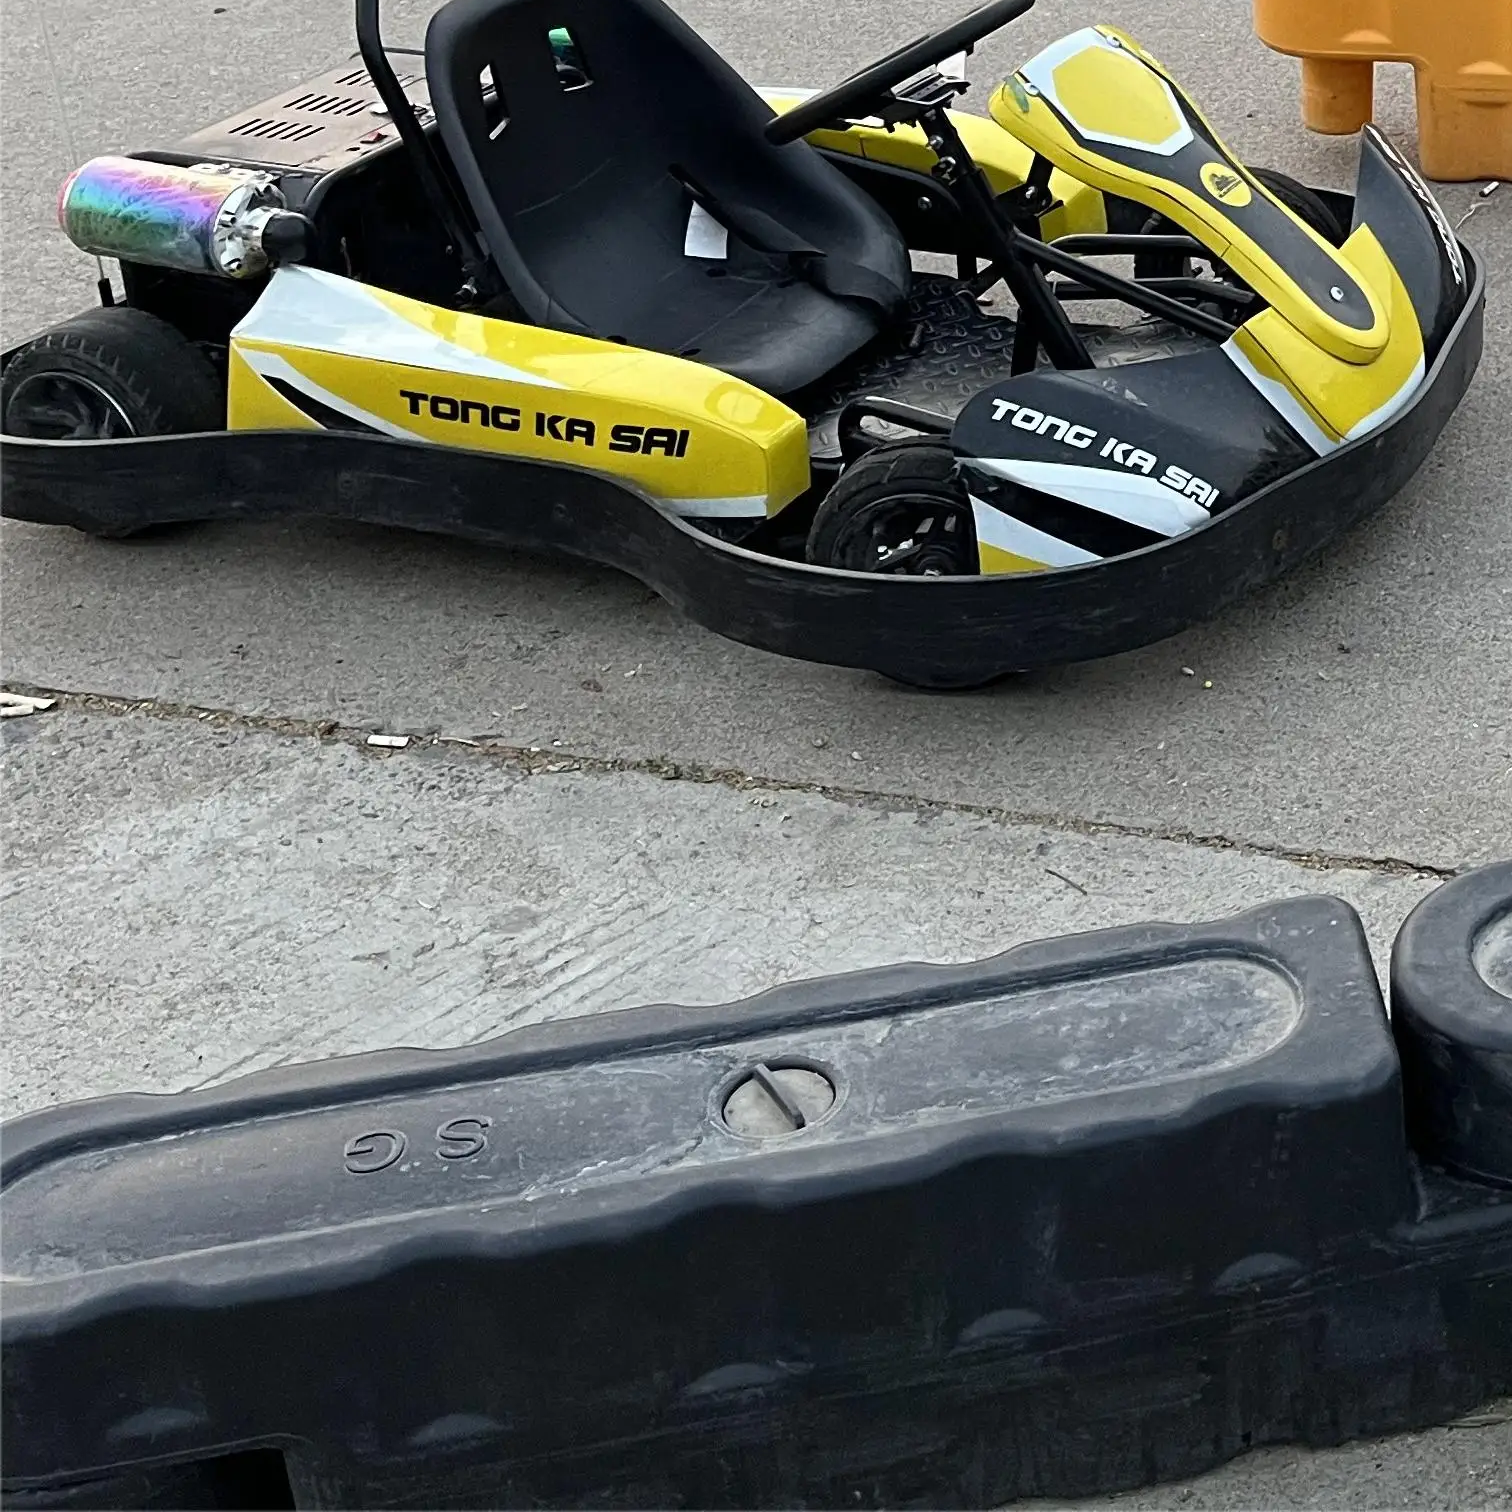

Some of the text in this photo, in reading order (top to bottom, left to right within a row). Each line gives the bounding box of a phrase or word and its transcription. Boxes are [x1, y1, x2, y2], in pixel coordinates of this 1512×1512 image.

[400, 390, 690, 458] TONG KA SAI
[991, 398, 1220, 508] TONG KA SAI
